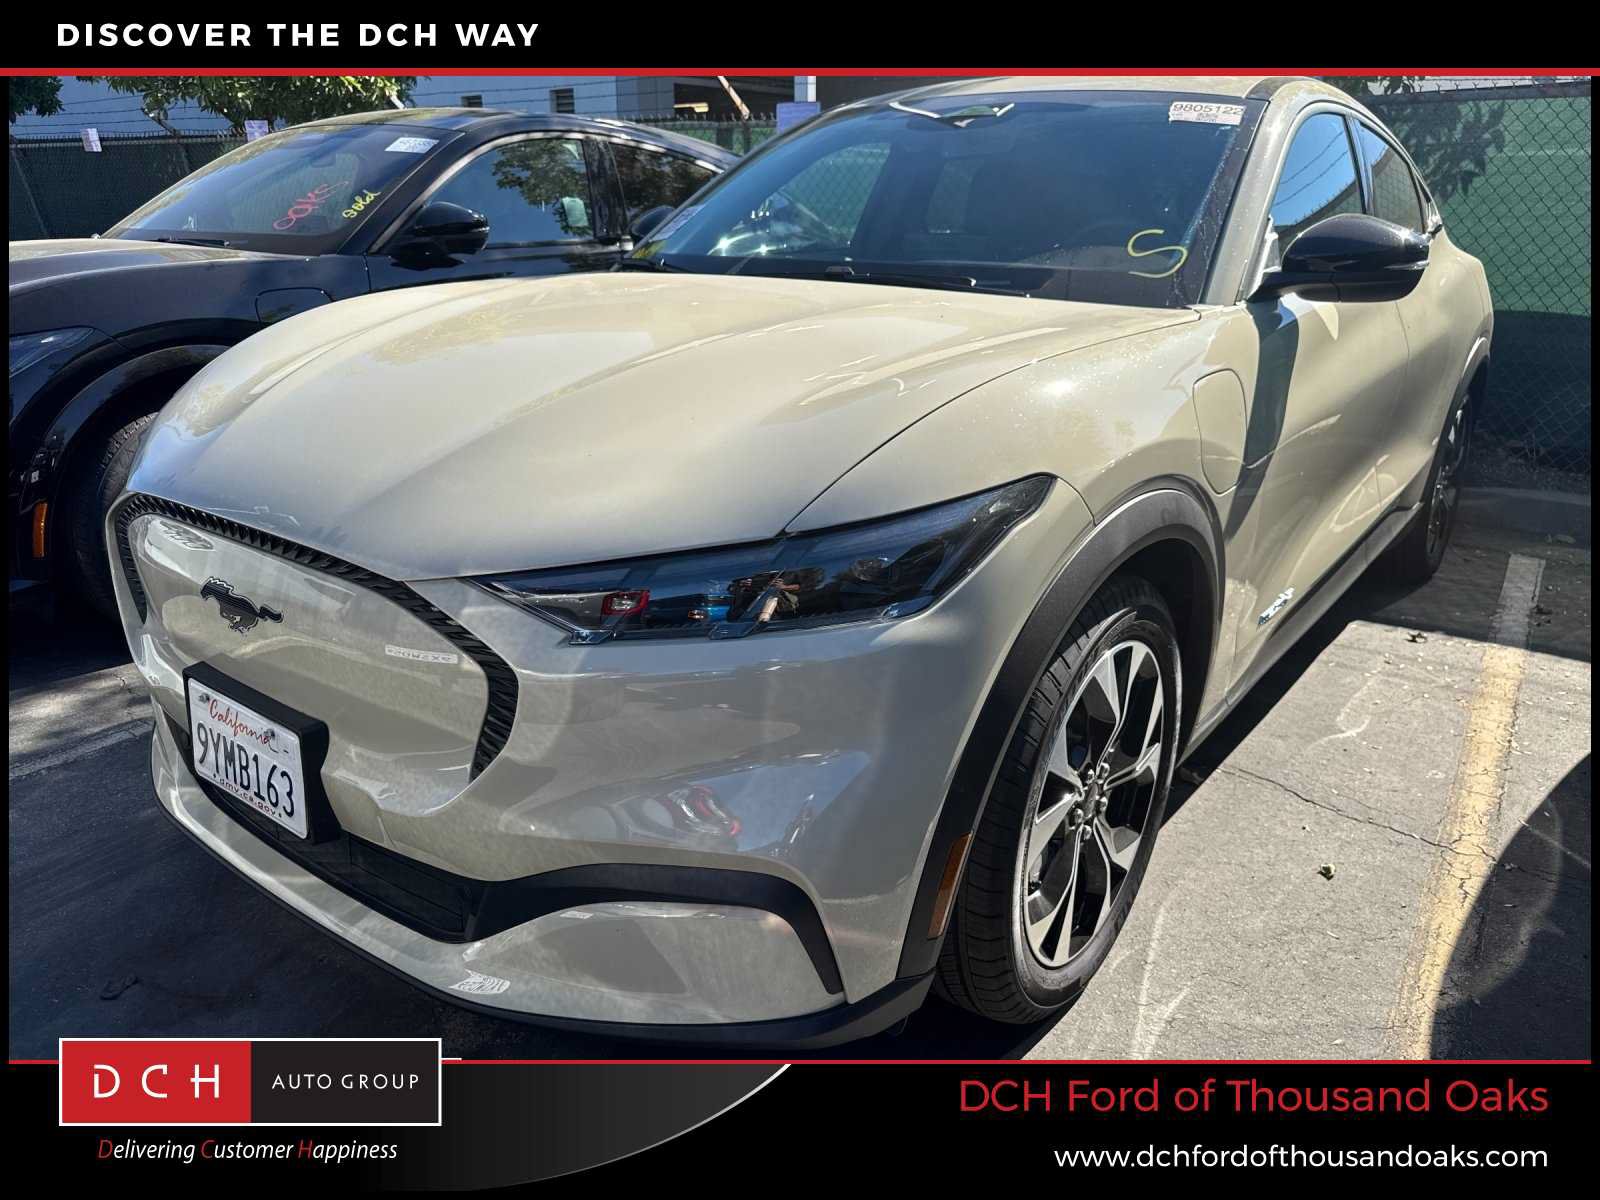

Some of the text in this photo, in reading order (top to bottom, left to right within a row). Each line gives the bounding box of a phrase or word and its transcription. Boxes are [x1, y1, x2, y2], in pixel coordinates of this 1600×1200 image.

[1127, 228, 1188, 278] S
[209, 699, 272, 745] California
[197, 722, 295, 818] 9YMB163
